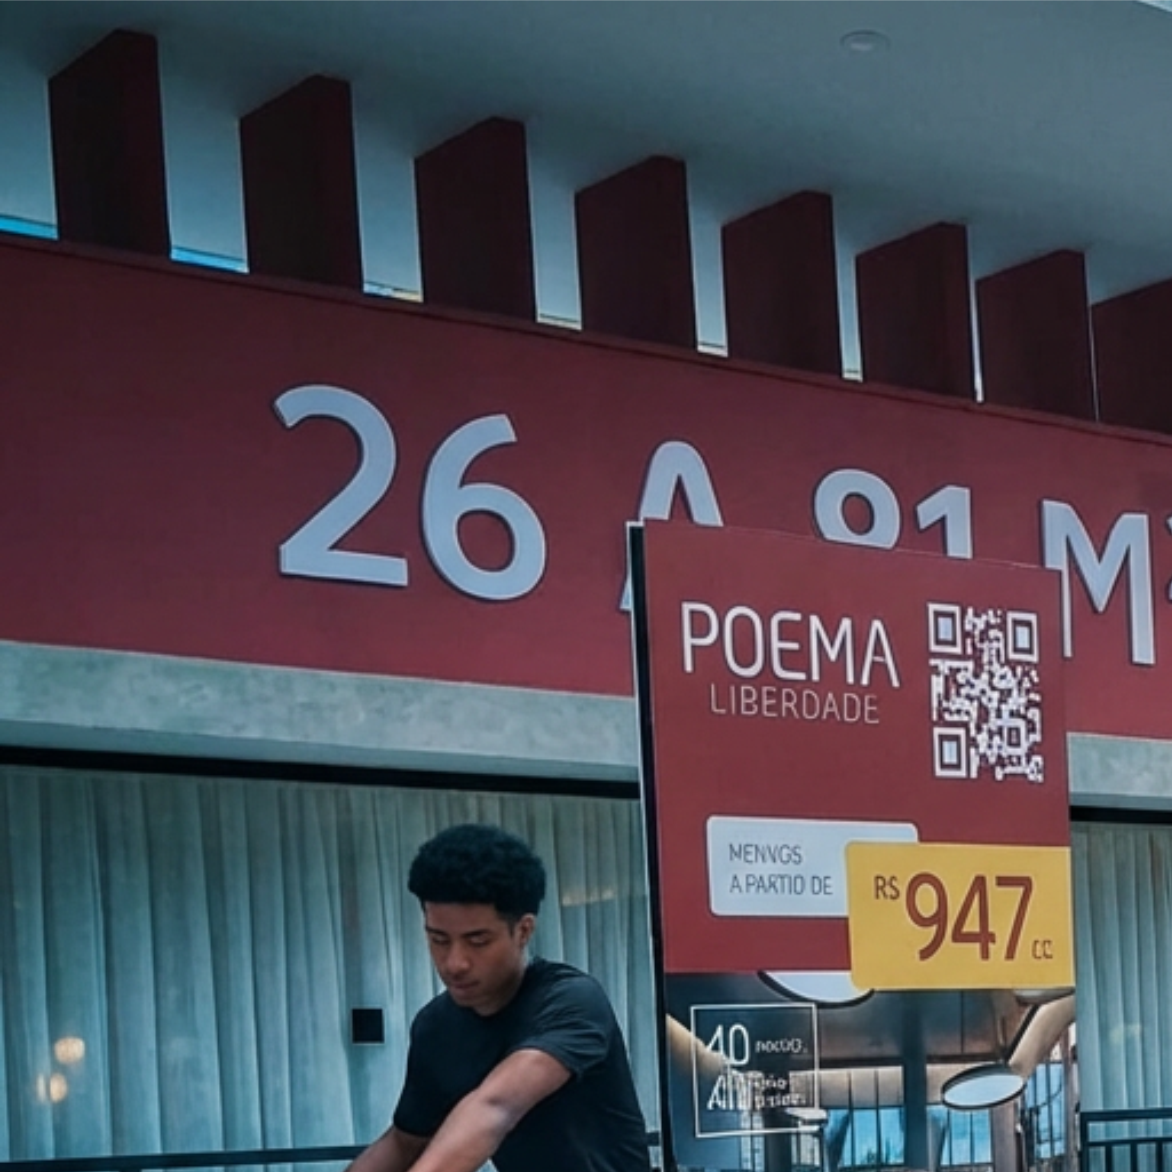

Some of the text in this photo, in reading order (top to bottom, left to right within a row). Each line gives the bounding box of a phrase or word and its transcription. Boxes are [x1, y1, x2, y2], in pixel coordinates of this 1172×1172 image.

[274, 384, 547, 600] 26
[681, 601, 900, 688] POEMA
[711, 683, 880, 724] LIBERDADE
[811, 875, 833, 895] DE
[905, 872, 1033, 961] 947
